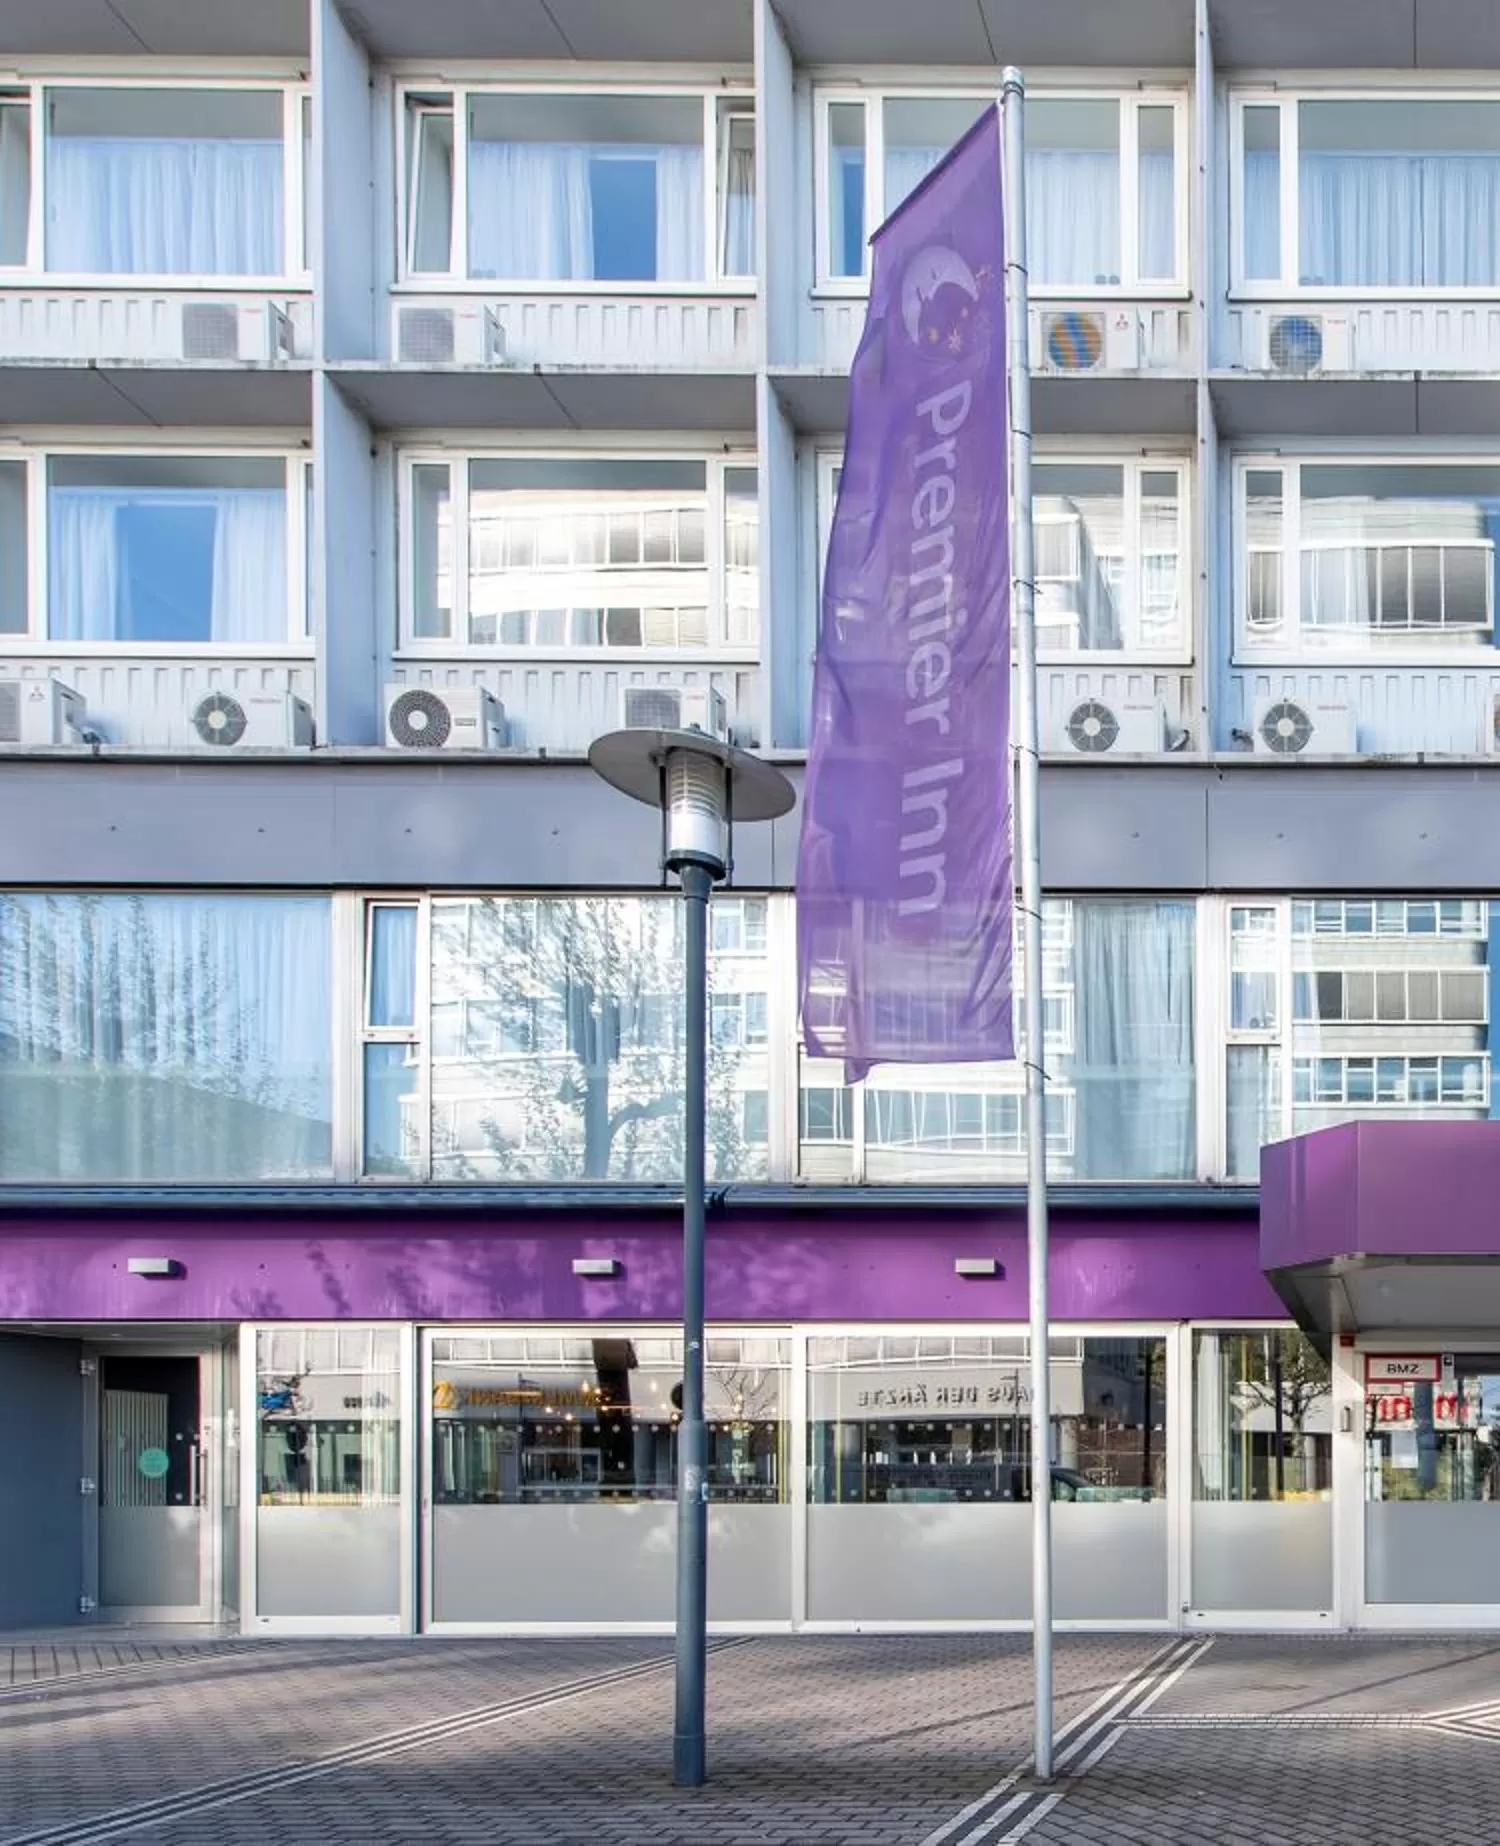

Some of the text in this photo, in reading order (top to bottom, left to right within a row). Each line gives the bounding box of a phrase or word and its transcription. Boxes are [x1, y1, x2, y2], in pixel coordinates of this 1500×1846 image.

[898, 379, 973, 917] Premier Inn
[1386, 1362, 1419, 1375] BMZ
